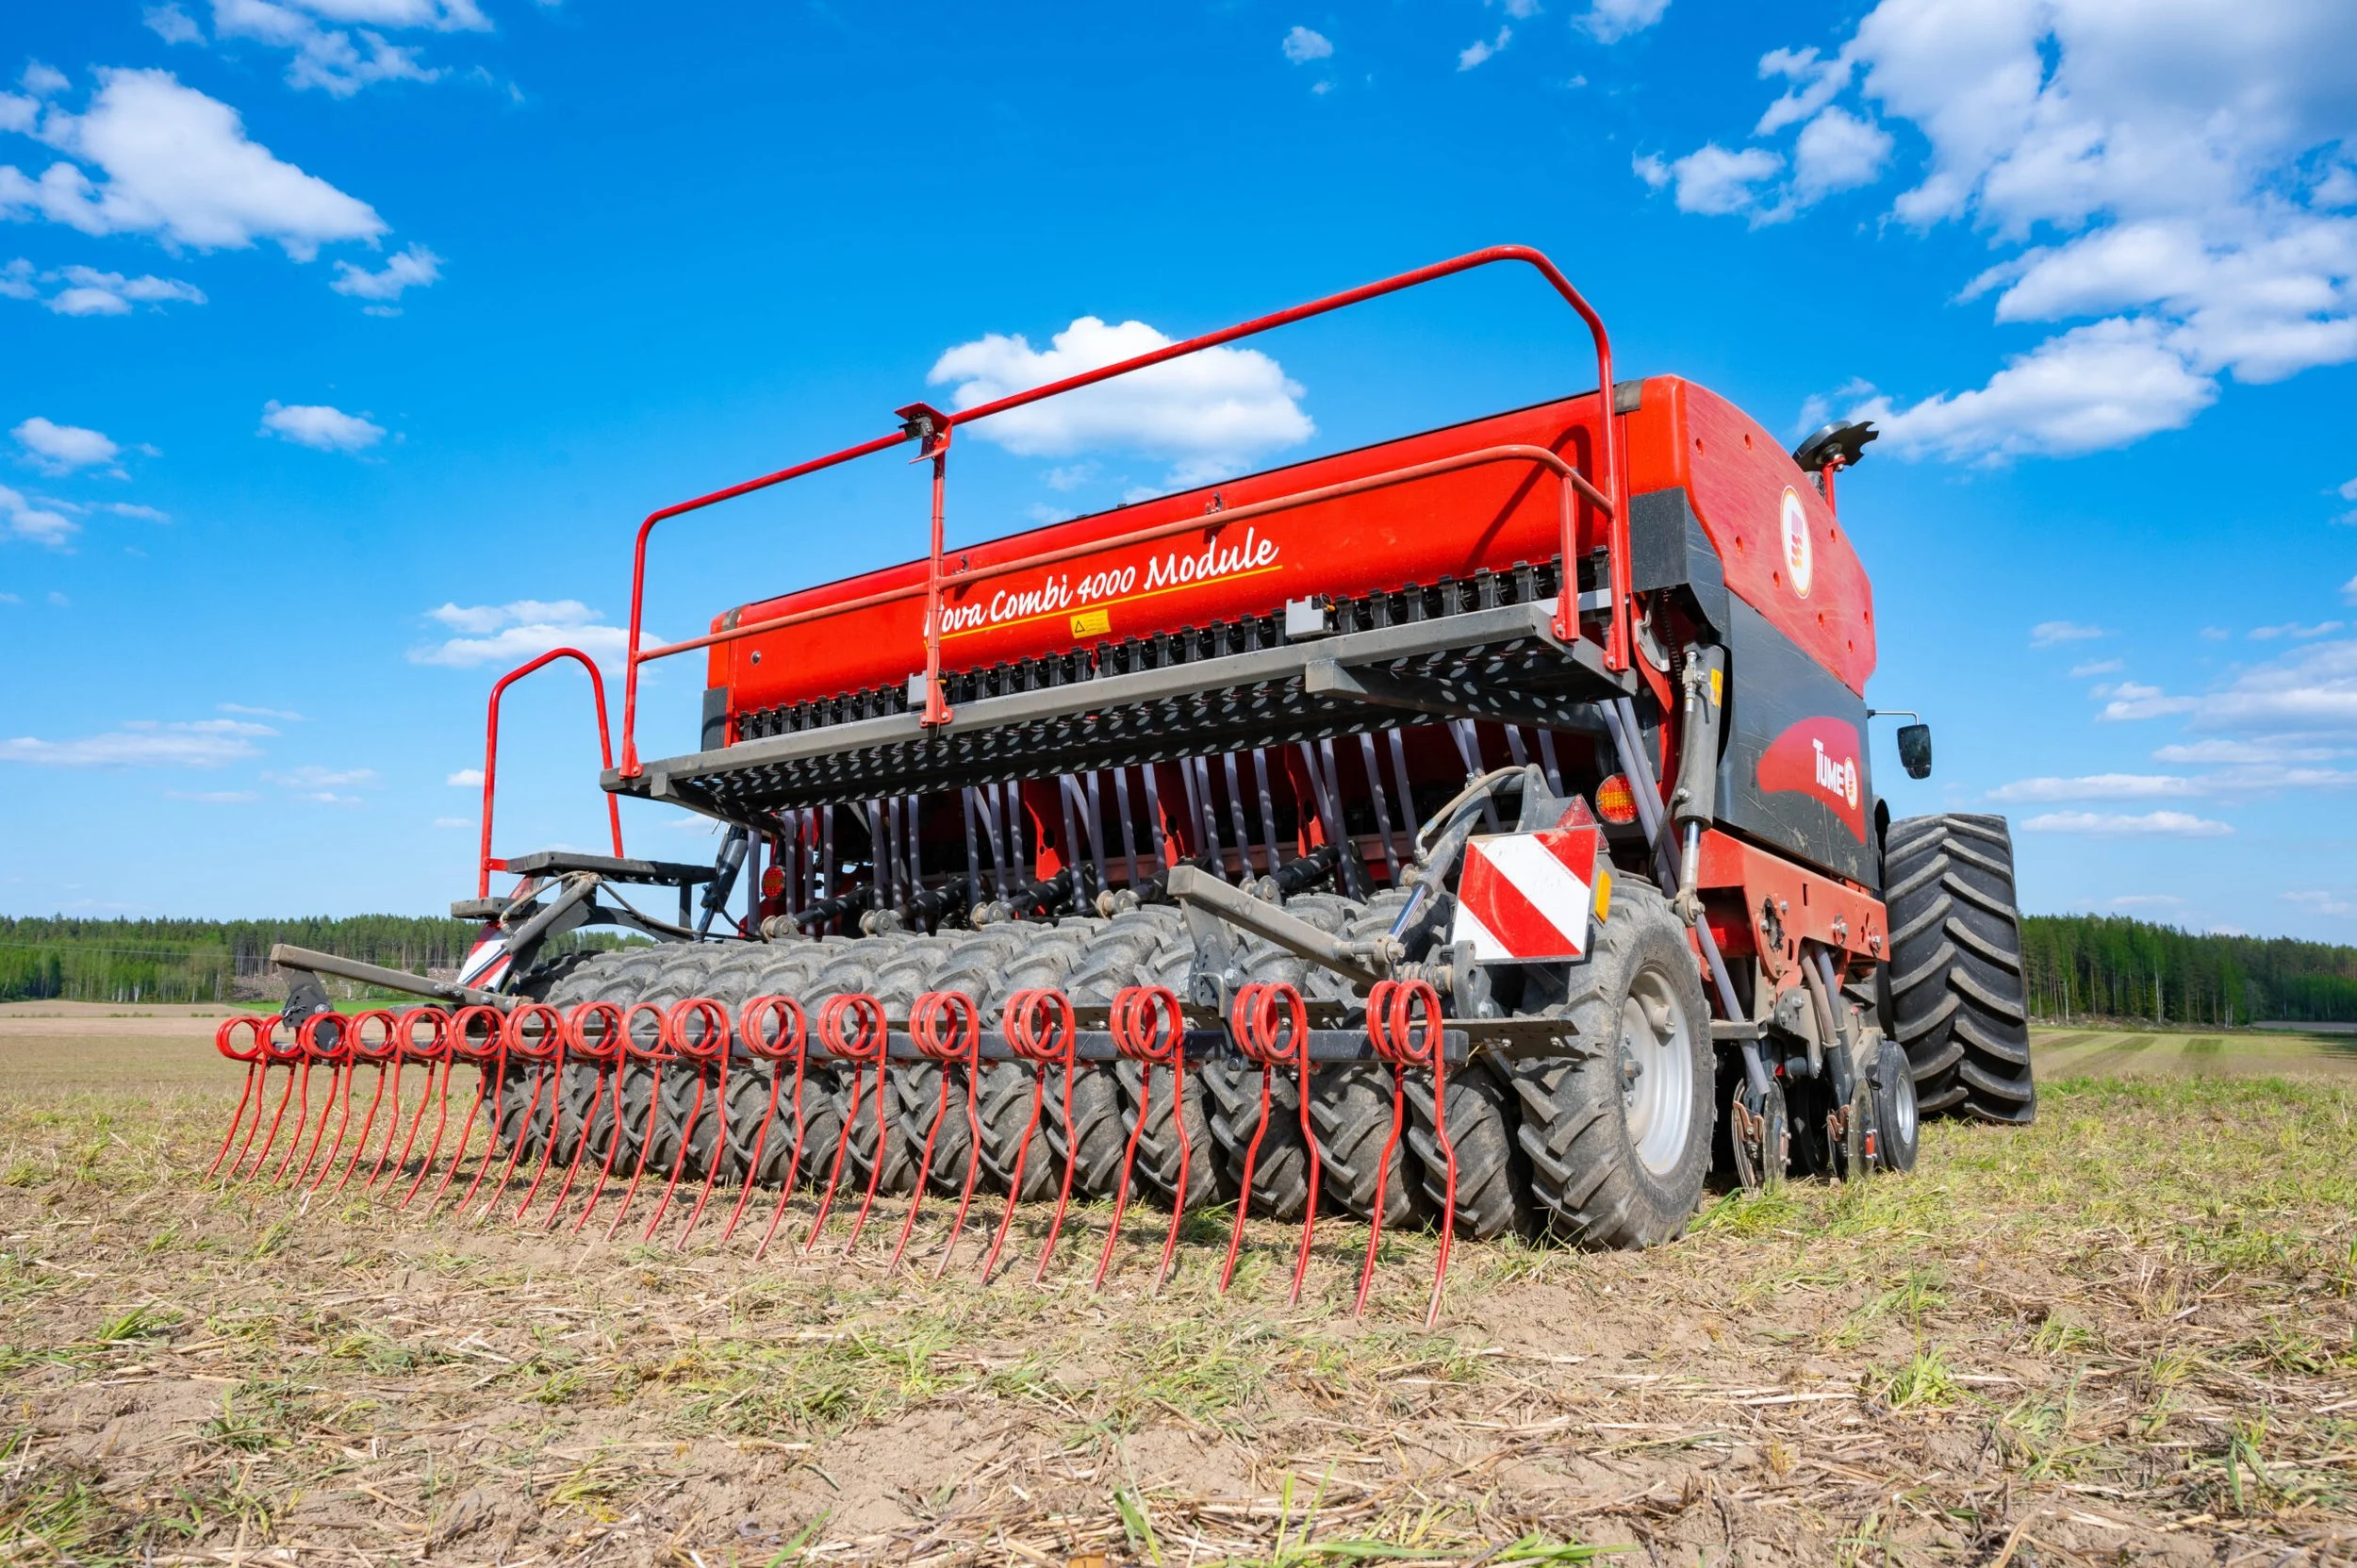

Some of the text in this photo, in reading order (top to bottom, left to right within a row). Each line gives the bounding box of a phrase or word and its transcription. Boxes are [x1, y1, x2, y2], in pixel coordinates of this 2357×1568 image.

[990, 574, 1073, 622] Combi
[1077, 566, 1135, 603] 4000
[1144, 526, 1279, 590] Module
[1812, 737, 1844, 798] TUME
